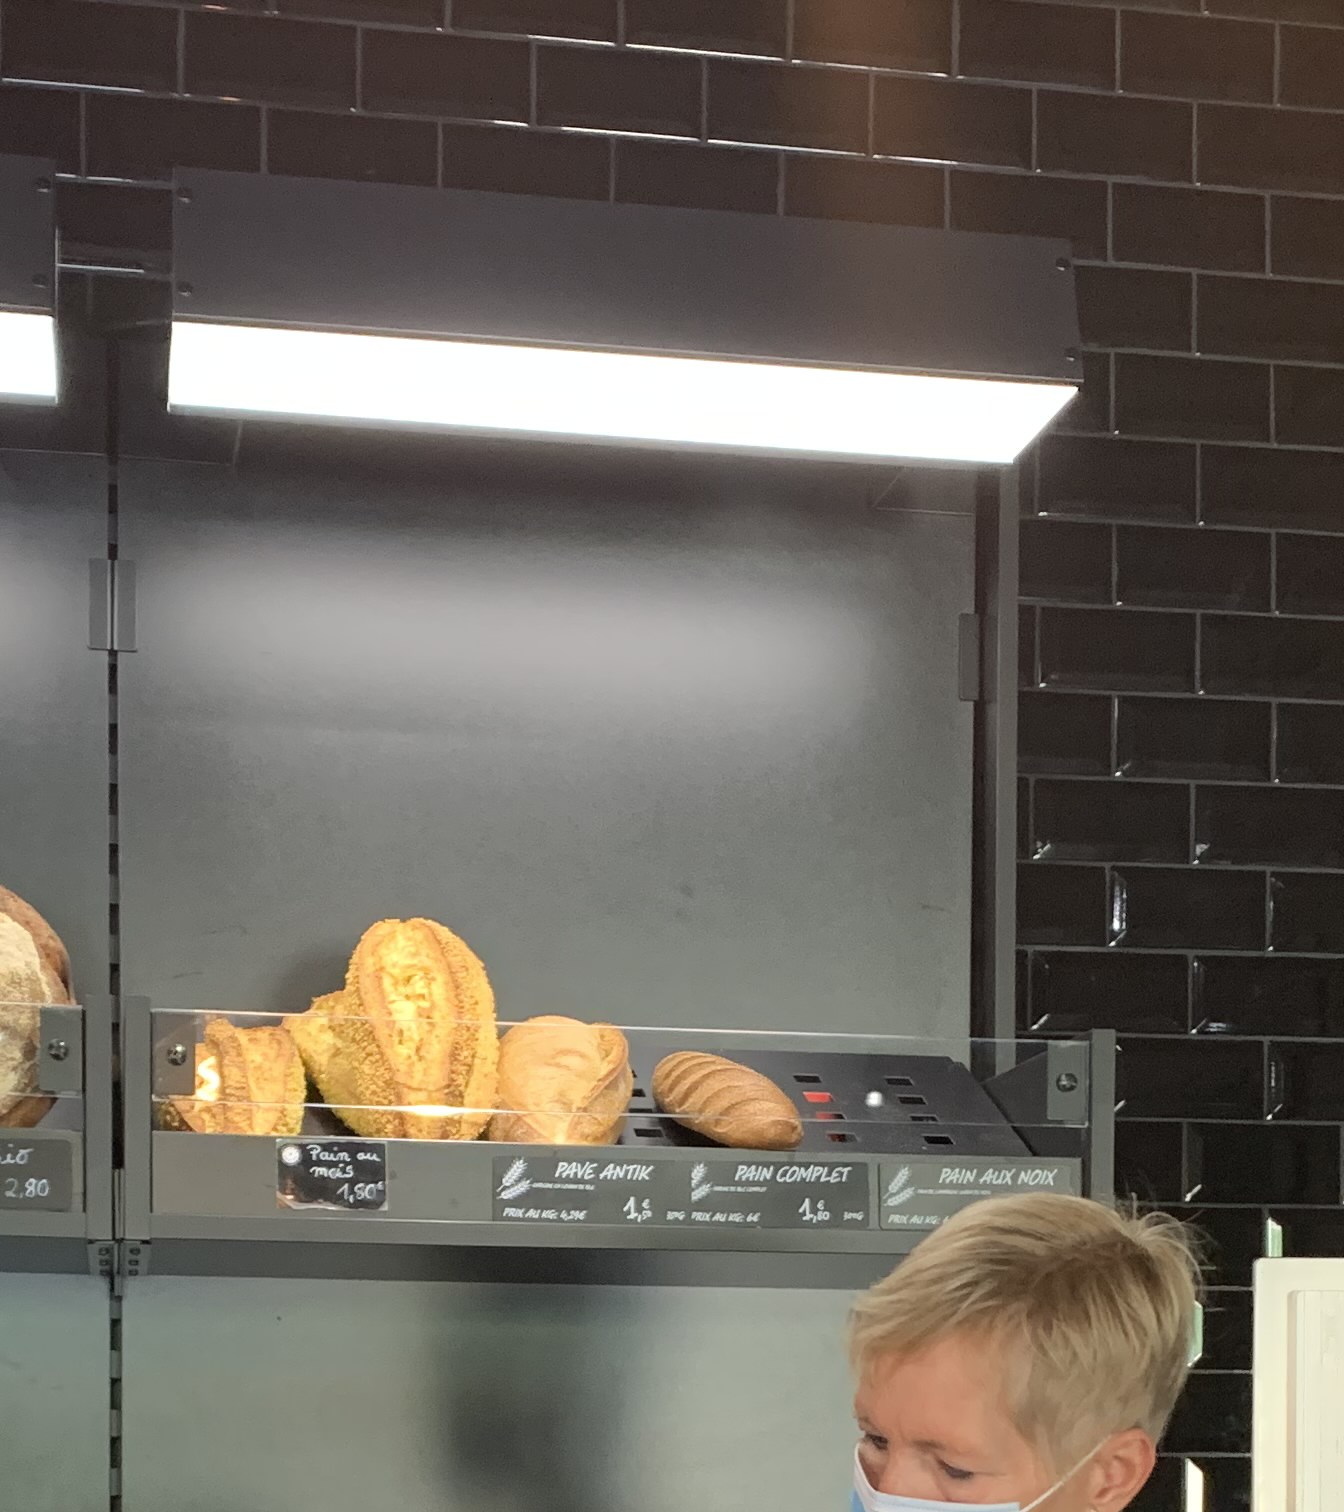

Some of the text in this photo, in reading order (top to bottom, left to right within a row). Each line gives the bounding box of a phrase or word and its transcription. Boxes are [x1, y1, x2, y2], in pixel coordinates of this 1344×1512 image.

[306, 1144, 381, 1162] Pain au
[555, 1162, 655, 1181] PAVE ANTIK
[735, 1165, 853, 1184] PAIN COMPLET
[939, 1168, 1058, 1187] PAIN AUX NOIX
[5, 1178, 50, 1199] 2,80
[503, 1207, 524, 1218] PRIX
[691, 1211, 710, 1221] PRIX
[888, 1214, 907, 1225] PRIX
